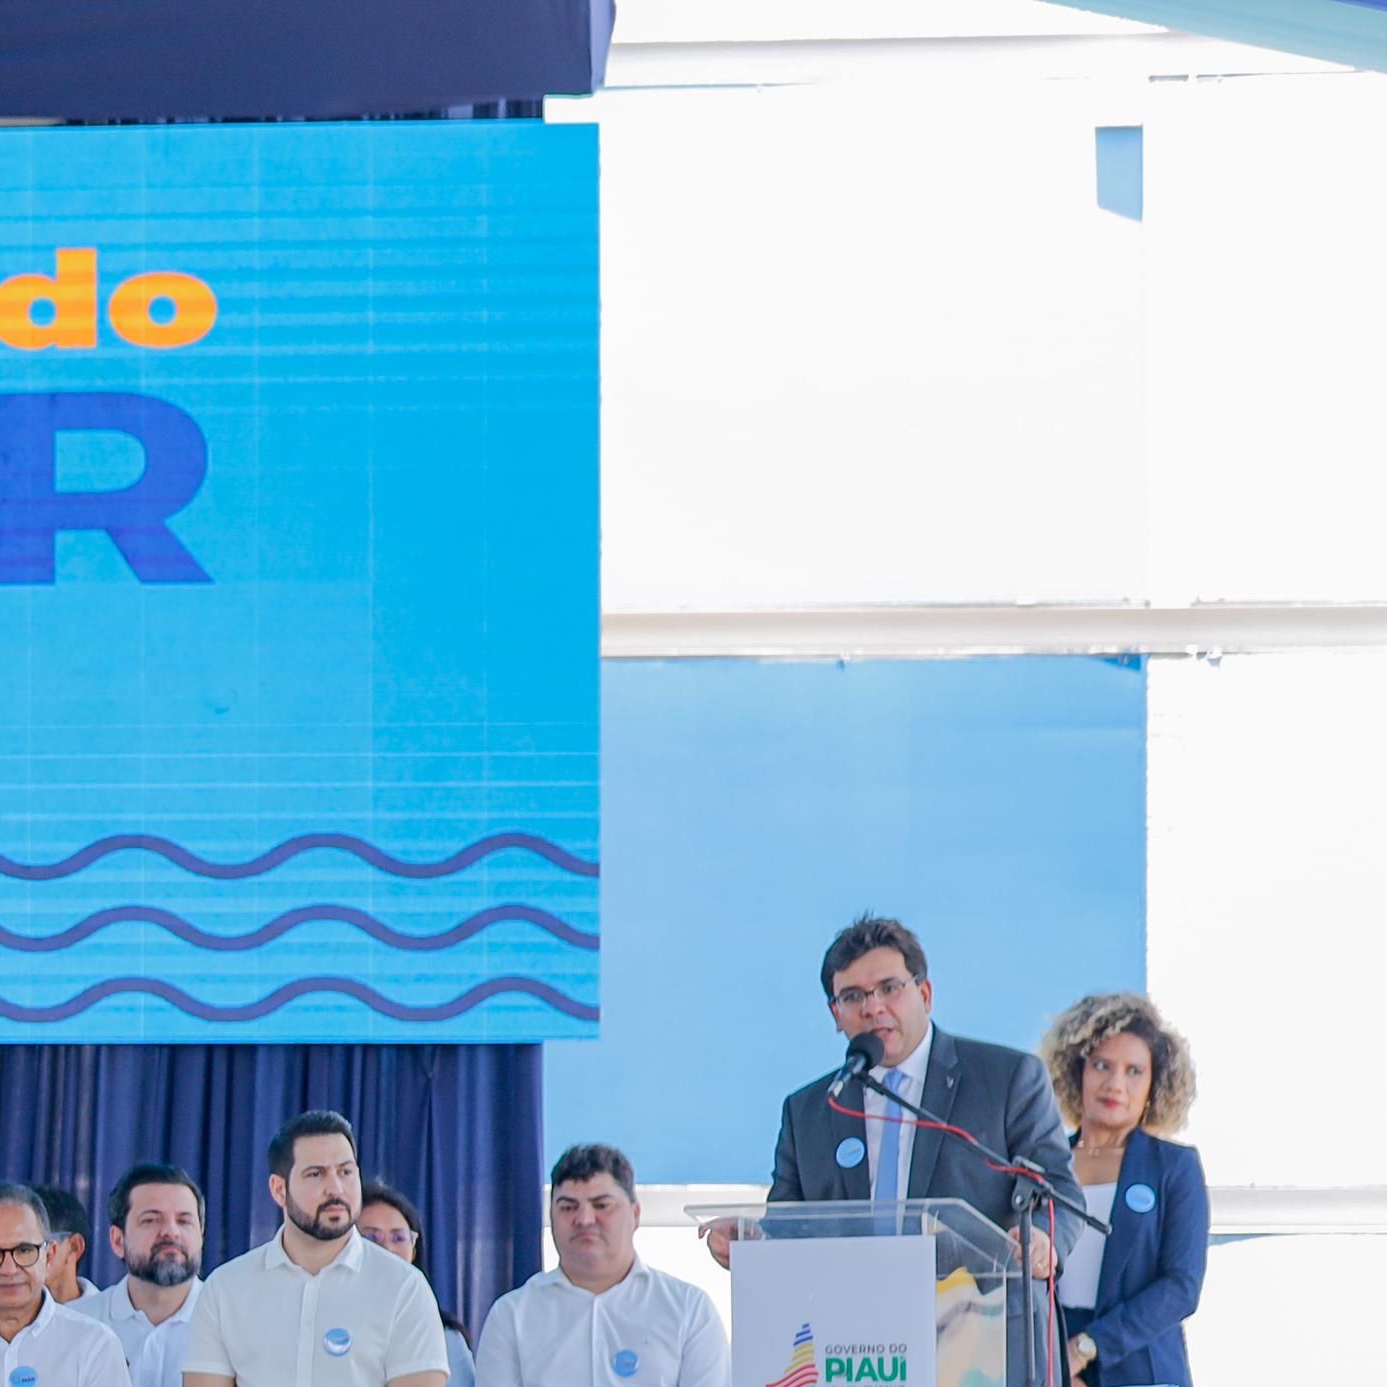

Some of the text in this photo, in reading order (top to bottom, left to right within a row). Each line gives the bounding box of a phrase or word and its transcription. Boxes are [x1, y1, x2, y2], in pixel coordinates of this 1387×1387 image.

[825, 1342, 908, 1354] GOVERNO DO
[825, 1355, 908, 1383] PIAUÍ
